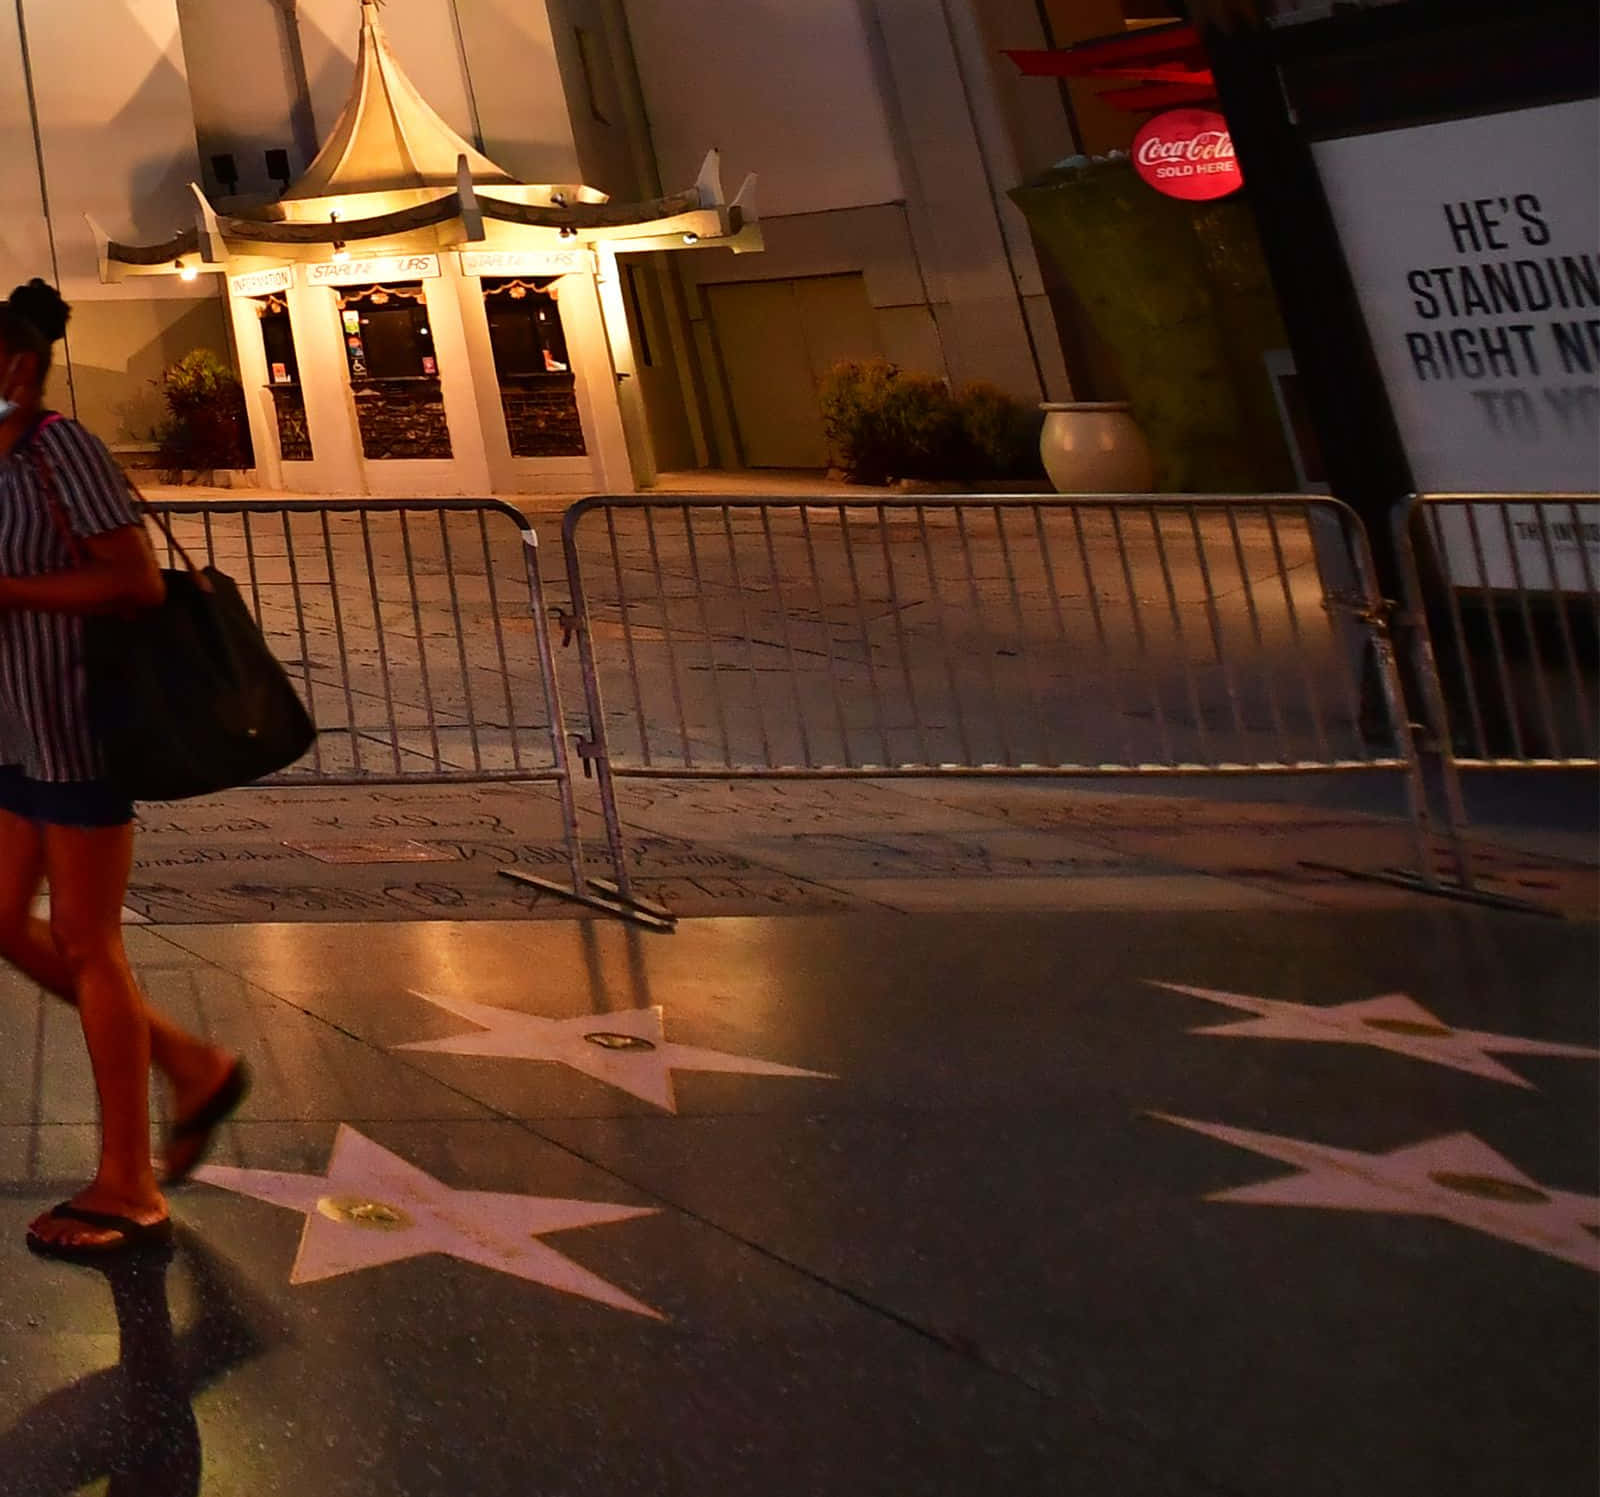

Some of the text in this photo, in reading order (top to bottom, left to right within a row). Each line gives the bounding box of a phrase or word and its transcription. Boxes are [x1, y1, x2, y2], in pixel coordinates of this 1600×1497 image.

[1138, 131, 1235, 165] Coca-Cola
[1156, 161, 1234, 179] SOLD HERE
[1444, 194, 1550, 253] HE'S
[1407, 254, 1600, 319] STANDIN
[1405, 325, 1539, 381] RIGHT
